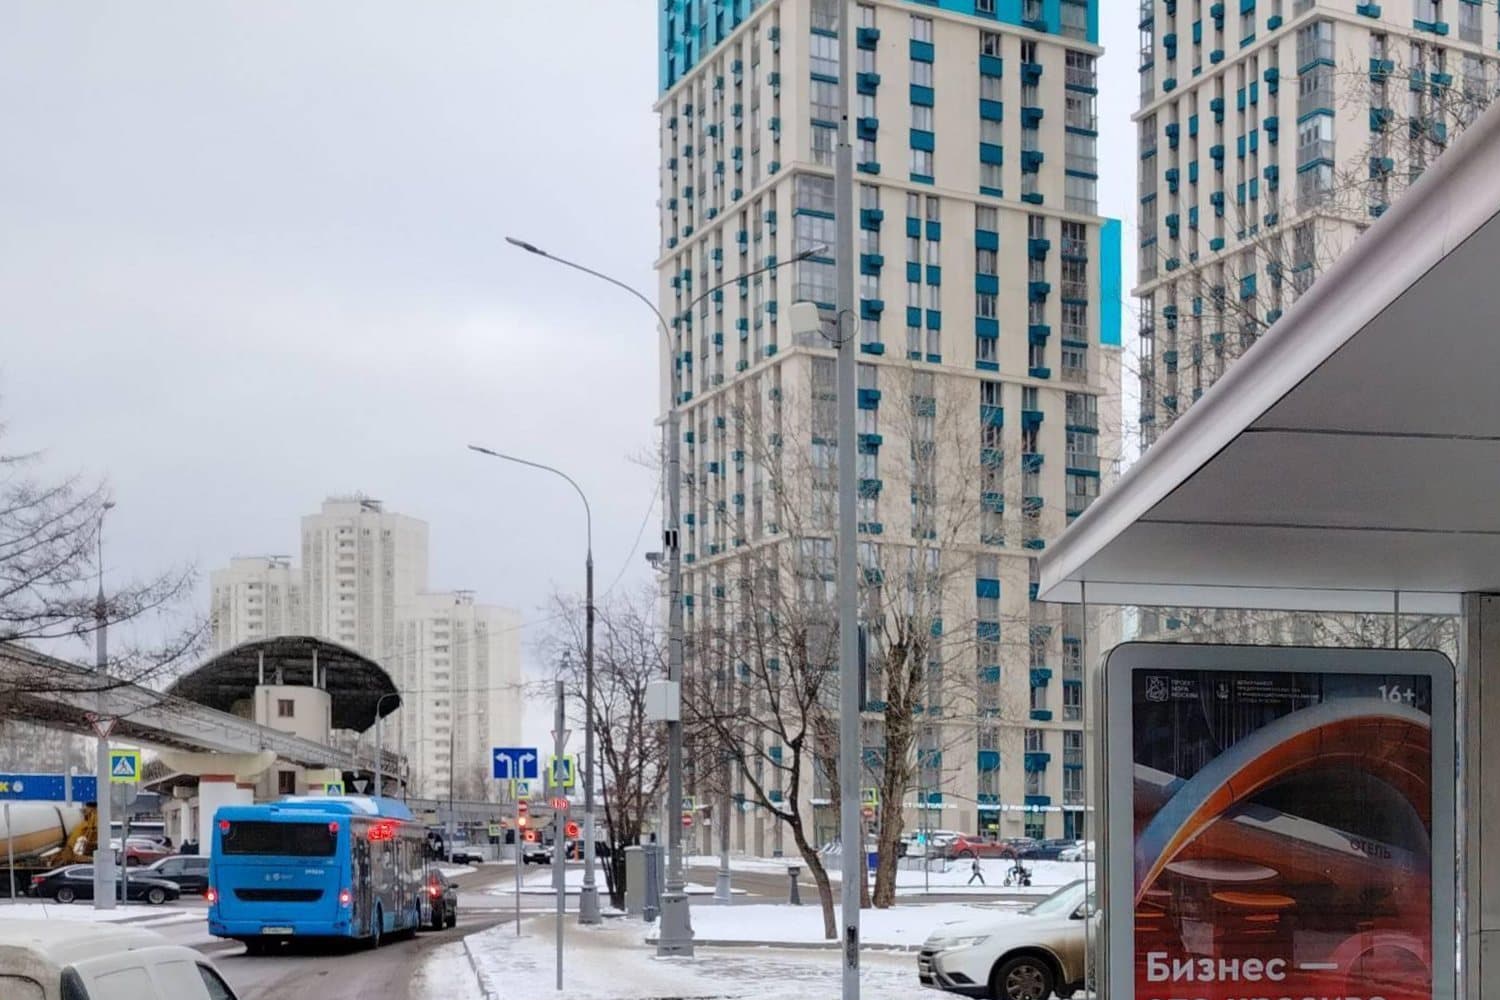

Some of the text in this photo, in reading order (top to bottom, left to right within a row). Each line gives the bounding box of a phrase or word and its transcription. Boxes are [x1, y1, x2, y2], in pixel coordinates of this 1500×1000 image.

[1378, 685, 1416, 703] 16+
[1350, 838, 1392, 860] ОТЕЛЬ
[1147, 952, 1286, 982] Бизнес
